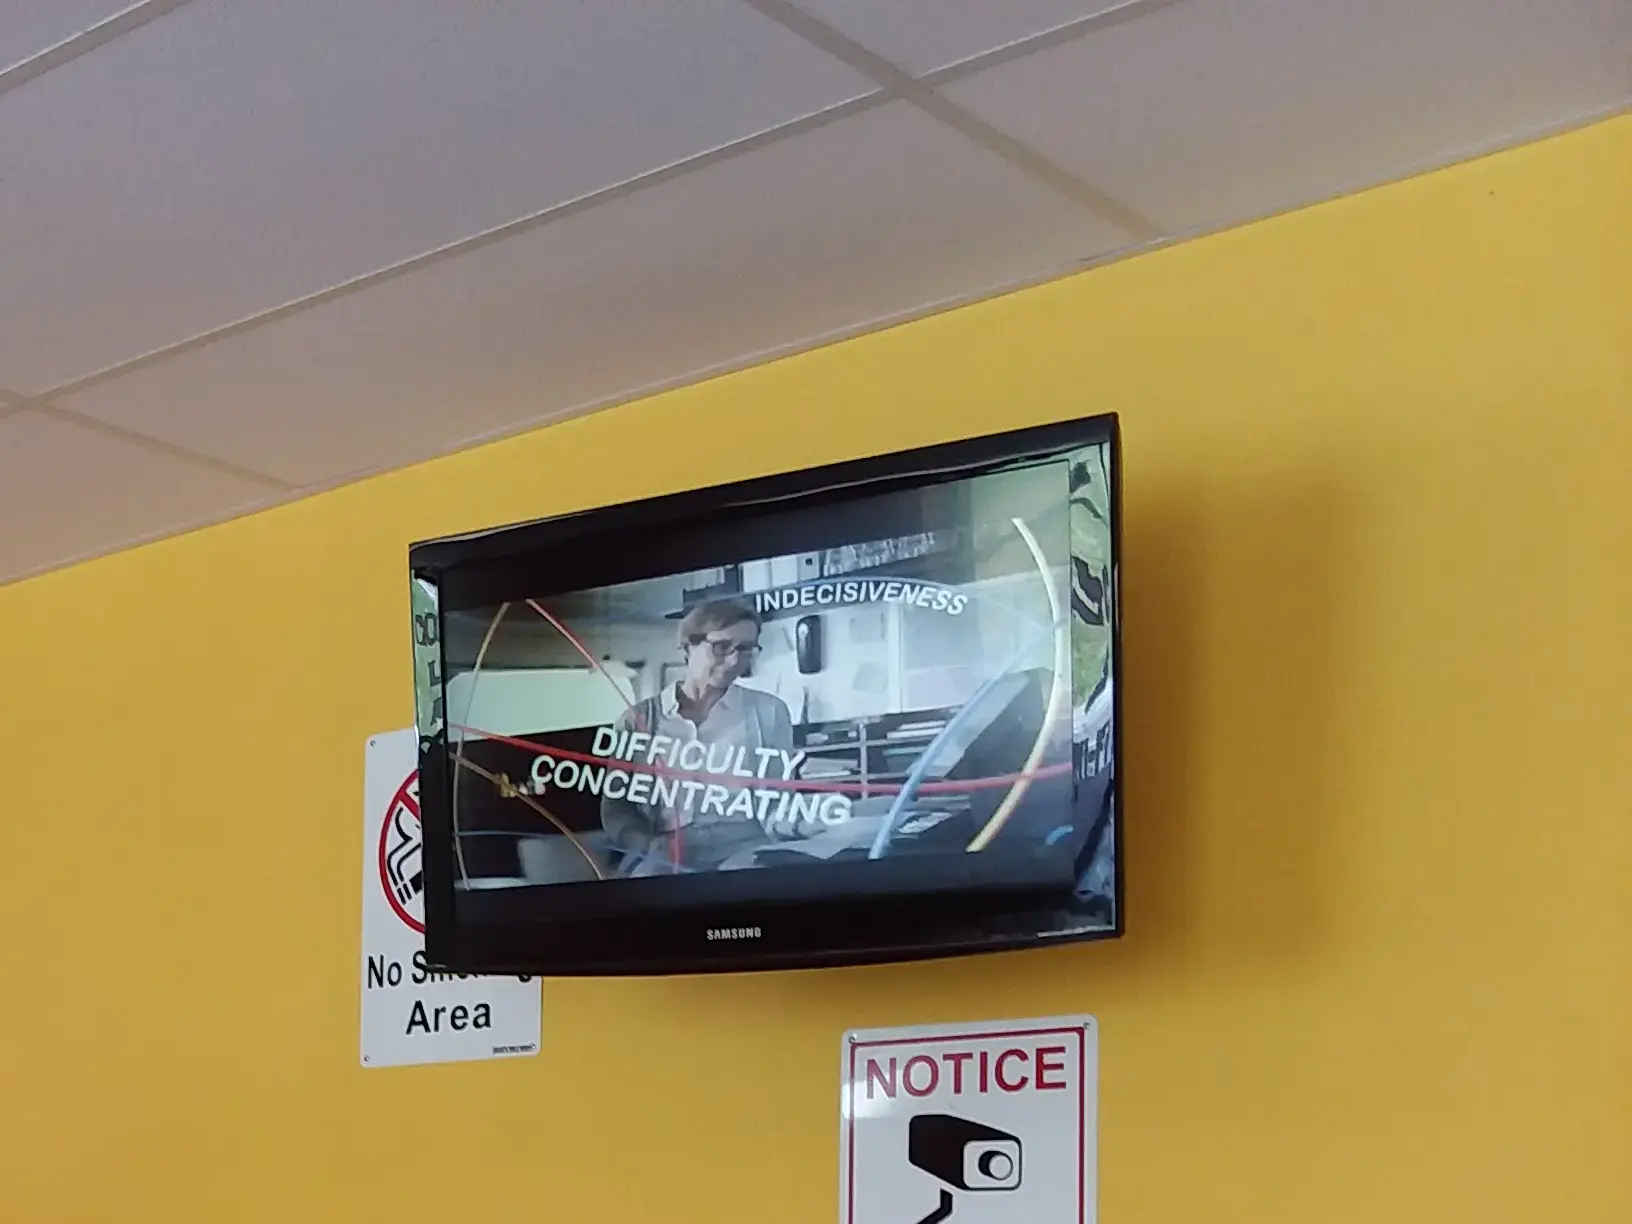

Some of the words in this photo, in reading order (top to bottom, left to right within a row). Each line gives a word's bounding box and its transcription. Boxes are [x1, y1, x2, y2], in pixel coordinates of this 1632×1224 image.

[755, 581, 968, 616] INDECISIVENESS
[591, 727, 805, 781] DIFFICULTY
[531, 755, 853, 825] CONCENTRATING
[706, 926, 762, 941] SAMSUNG
[368, 954, 403, 989] No
[405, 1000, 492, 1035] Area
[866, 1046, 1067, 1099] NOTICE
